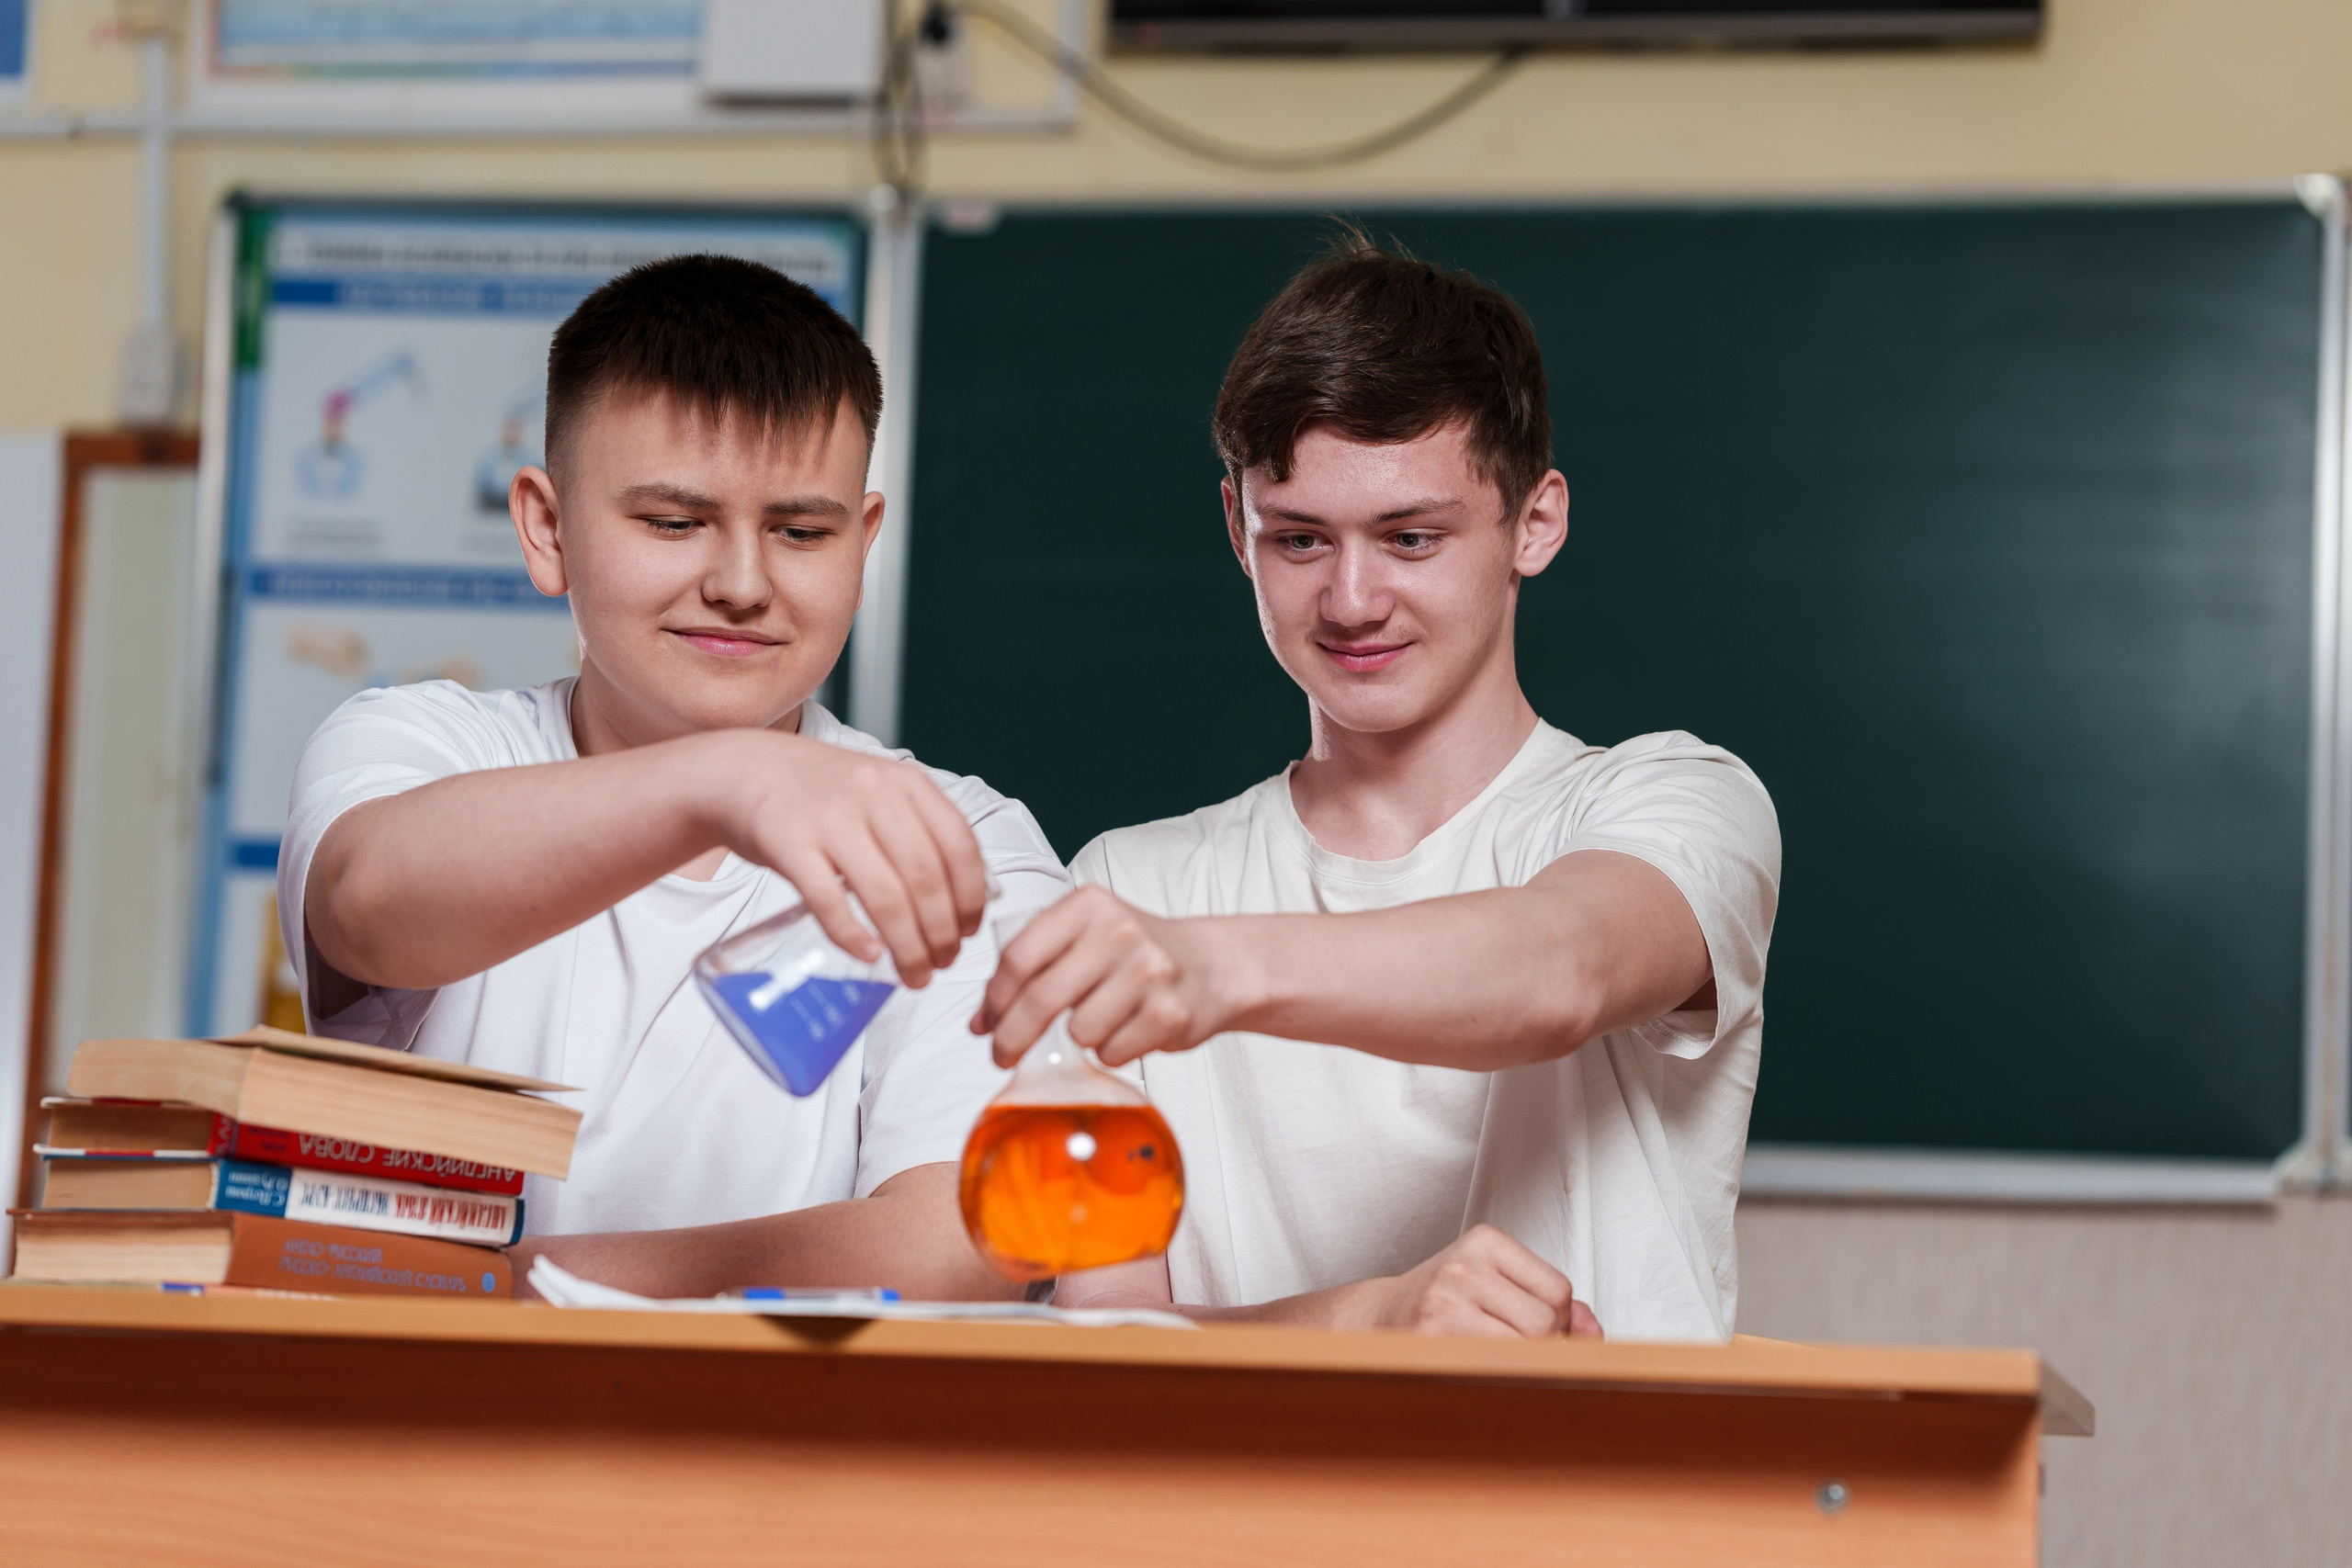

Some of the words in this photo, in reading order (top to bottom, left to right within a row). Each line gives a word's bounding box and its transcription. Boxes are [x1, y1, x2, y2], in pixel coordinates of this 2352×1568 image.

[299, 1132, 376, 1164] СЛОВА
[394, 1192, 427, 1221] ЯЗЫК
[429, 1196, 508, 1231] АНГЛИЙСКИЙ
